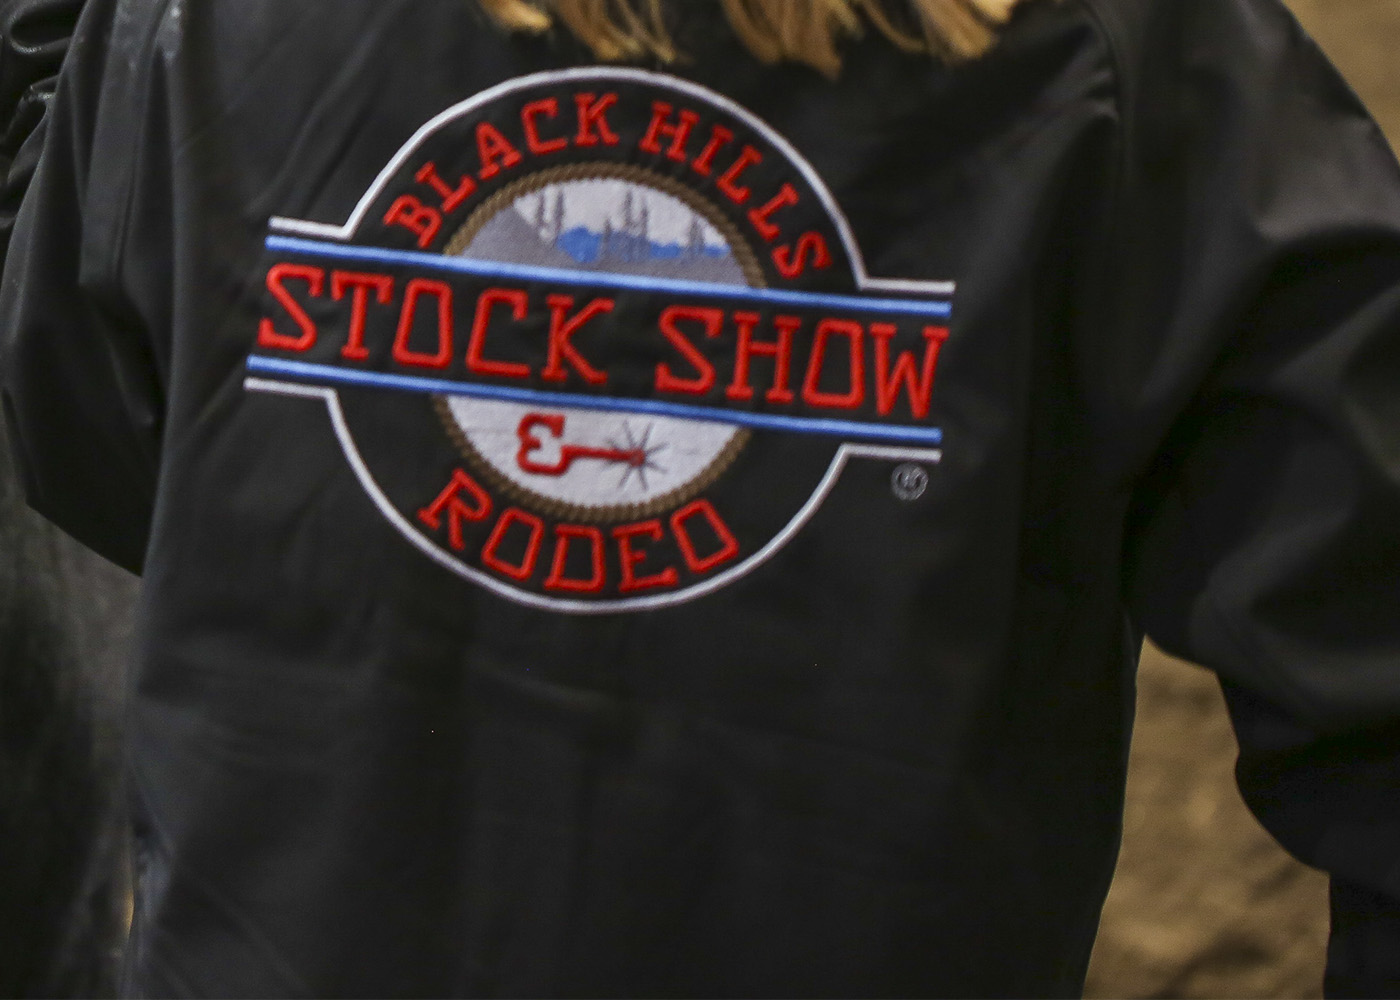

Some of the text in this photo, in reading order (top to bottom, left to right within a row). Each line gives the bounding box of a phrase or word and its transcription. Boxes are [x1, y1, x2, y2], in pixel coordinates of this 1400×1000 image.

[383, 91, 834, 280] BLACK HILLS
[255, 261, 951, 420] STOCK SHOW
[416, 466, 741, 595] RODEO
